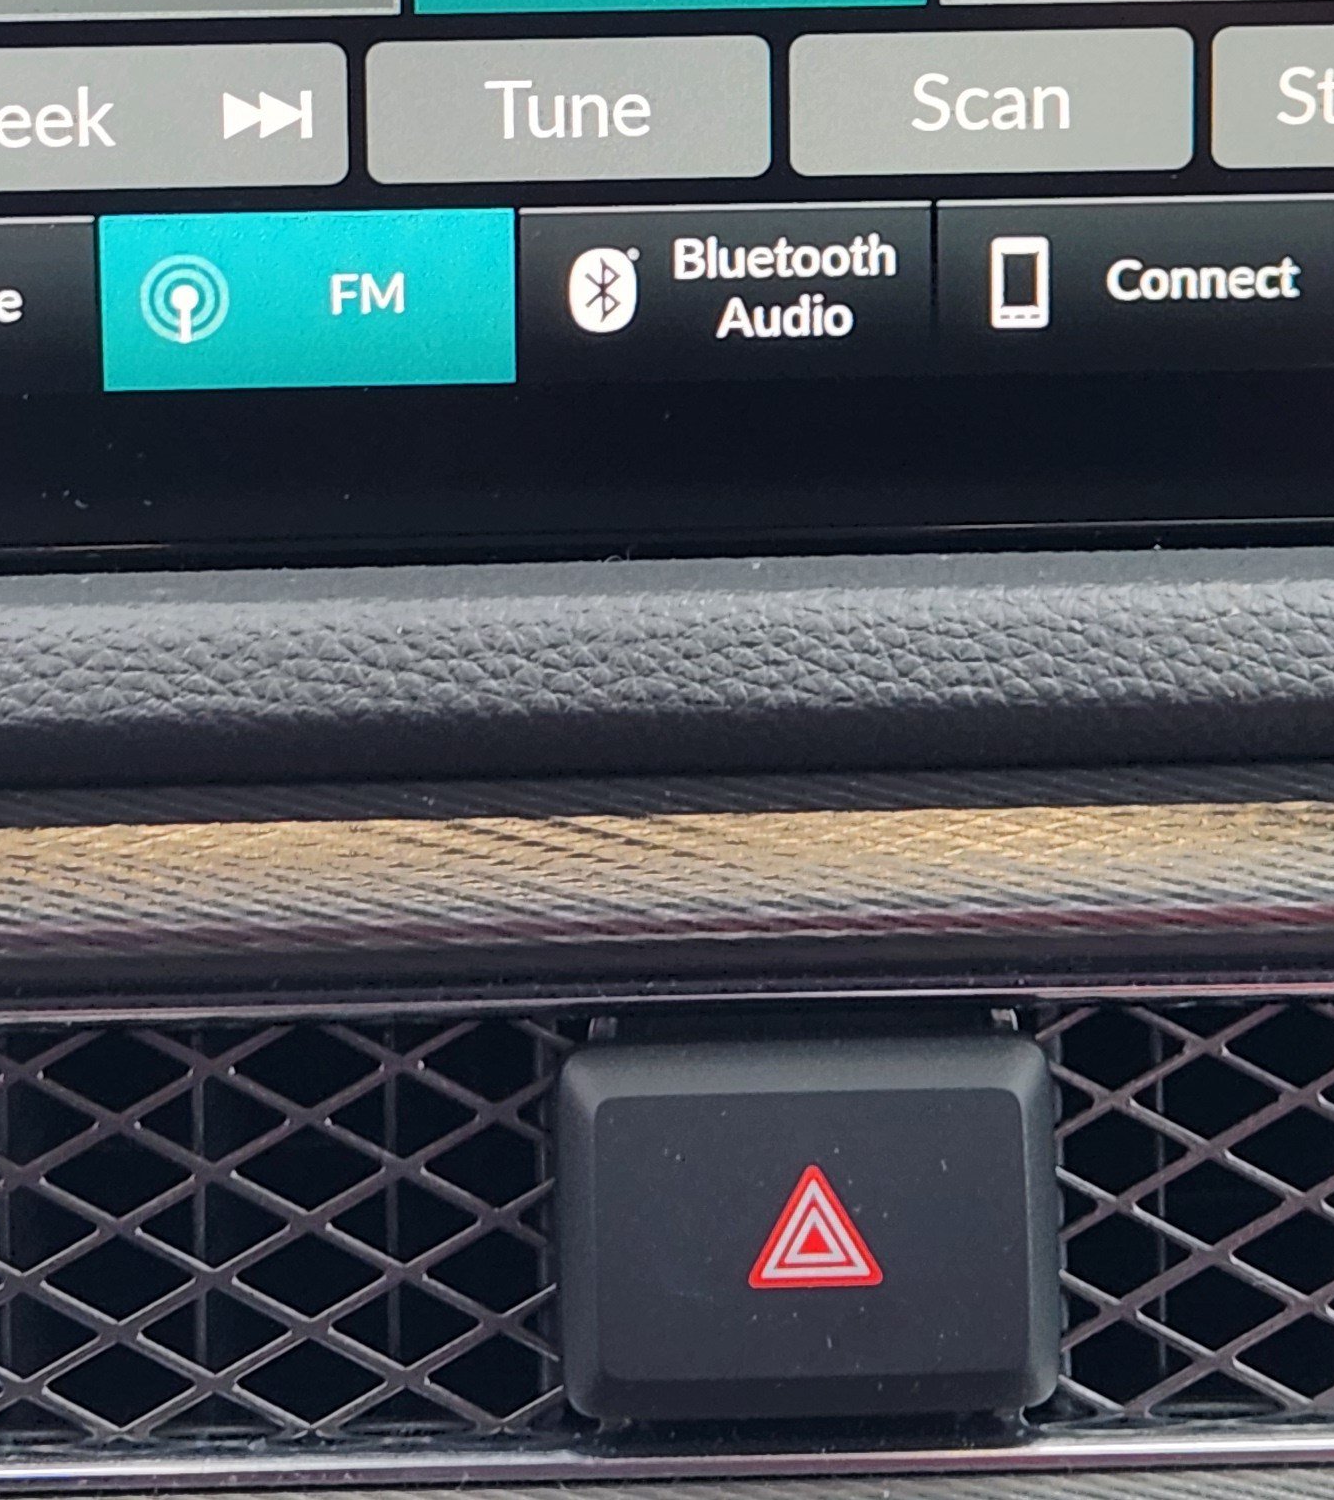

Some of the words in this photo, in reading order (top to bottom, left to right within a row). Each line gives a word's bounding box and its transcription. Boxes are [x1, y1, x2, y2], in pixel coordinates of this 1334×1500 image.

[484, 79, 654, 140] Tune
[907, 70, 1072, 134] Scan
[672, 235, 899, 284] Bluetooth
[1105, 256, 1301, 303] Connect
[328, 272, 407, 316] FM
[715, 296, 855, 342] Audio
